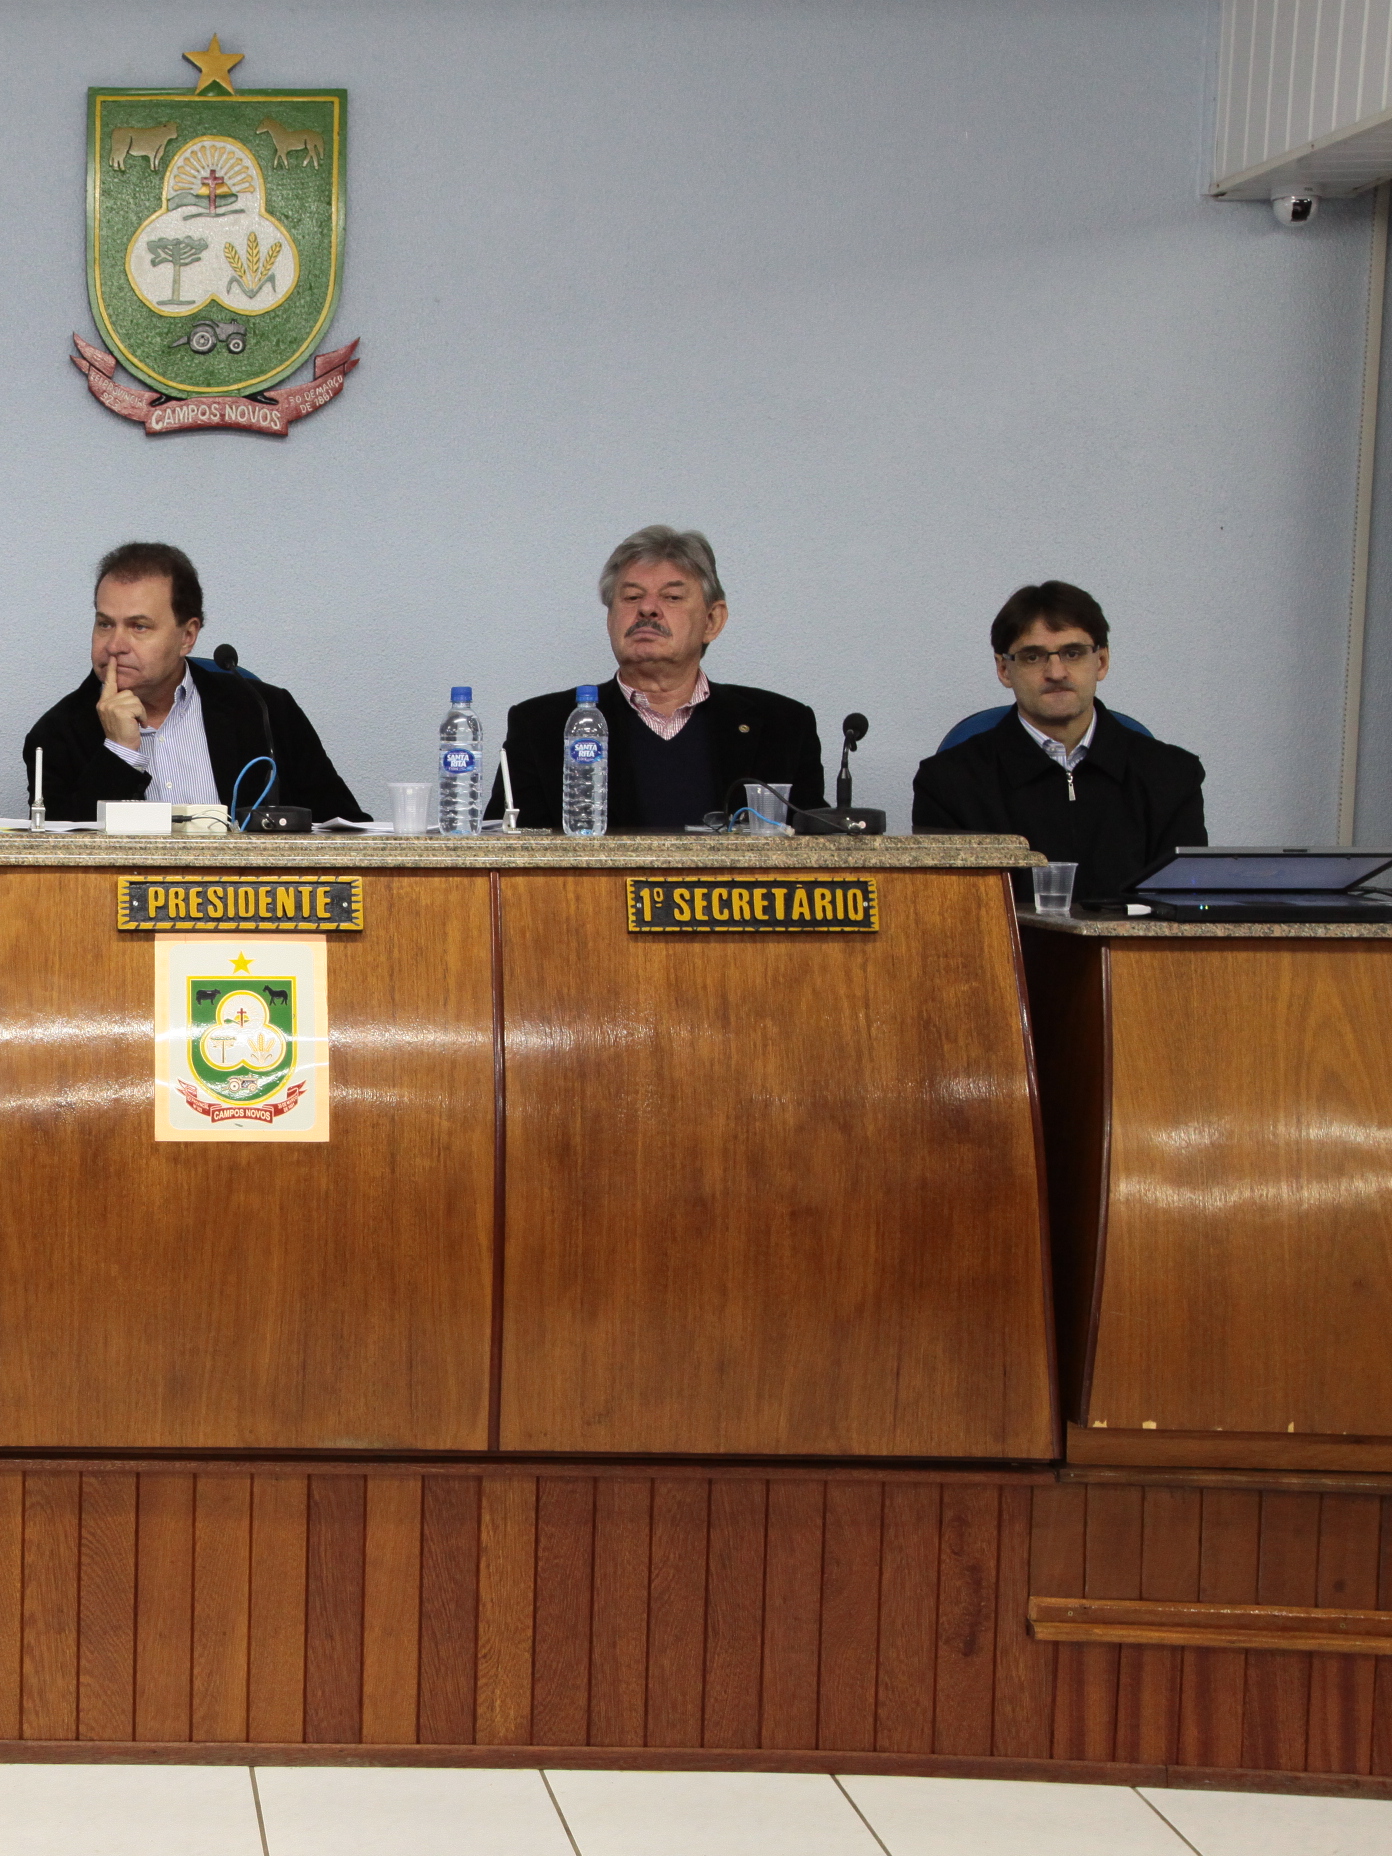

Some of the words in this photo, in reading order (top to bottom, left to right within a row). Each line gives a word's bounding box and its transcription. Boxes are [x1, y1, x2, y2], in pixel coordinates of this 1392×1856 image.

[303, 389, 316, 401] DE
[299, 402, 313, 413] DE
[151, 403, 220, 430] CAMPOS
[225, 404, 281, 430] NOVOS
[574, 743, 597, 752] SANTA
[447, 754, 470, 762] SANTA
[578, 750, 595, 758] RITA
[450, 760, 467, 768] RITA
[148, 887, 332, 918] PRESIDENTE
[673, 884, 865, 922] SECRETÁRIO
[213, 1108, 245, 1120] CAMPOS
[245, 1108, 271, 1121] NOVOS
